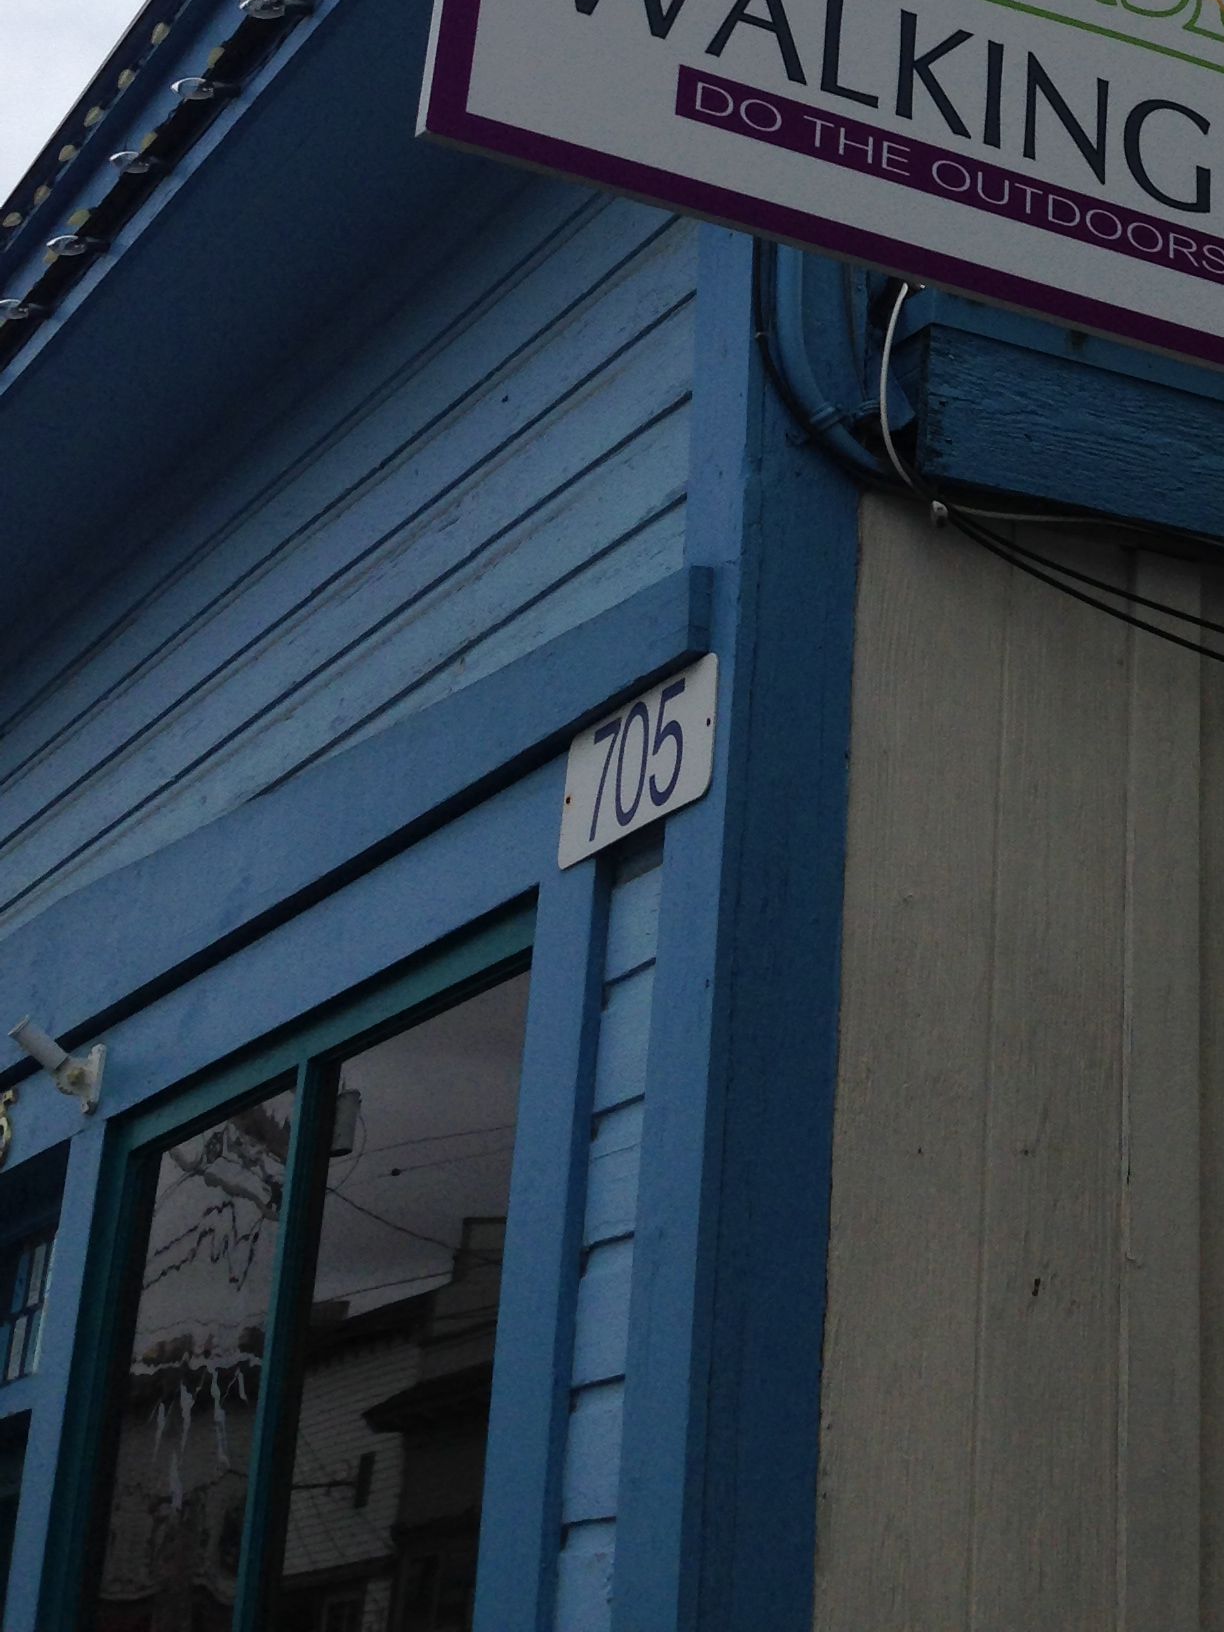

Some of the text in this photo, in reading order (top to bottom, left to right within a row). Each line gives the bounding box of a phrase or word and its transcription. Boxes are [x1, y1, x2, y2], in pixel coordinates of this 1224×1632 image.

[695, 81, 782, 132] DO
[803, 115, 911, 176] THE
[589, 677, 686, 842] 705
